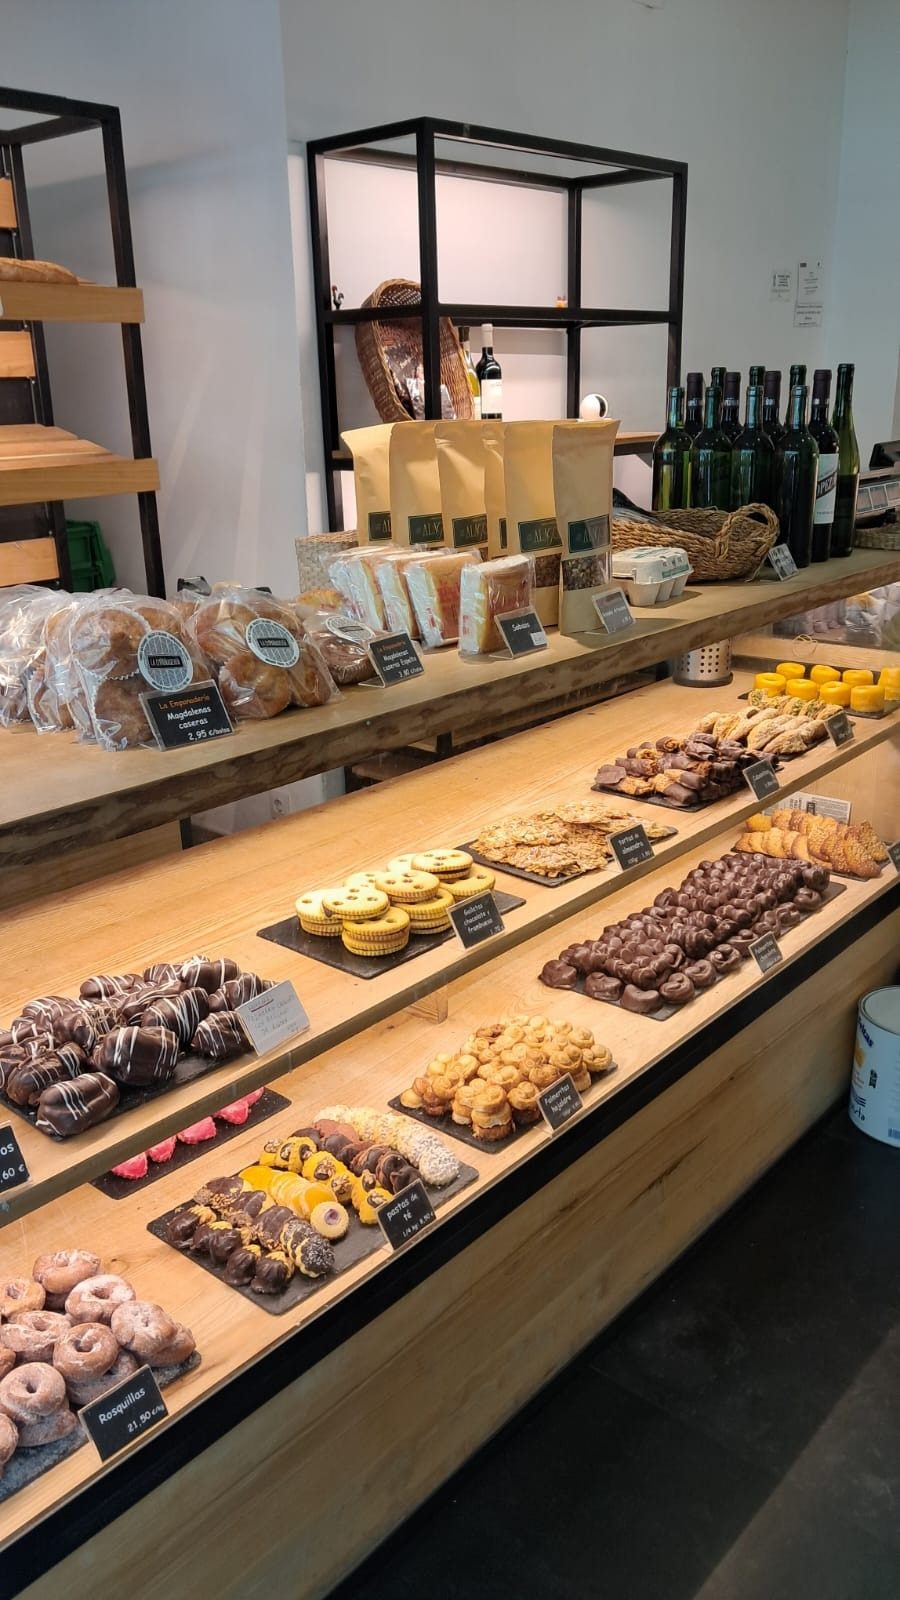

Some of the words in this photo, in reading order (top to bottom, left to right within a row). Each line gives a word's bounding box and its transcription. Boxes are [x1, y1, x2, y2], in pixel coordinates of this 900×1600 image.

[167, 706, 212, 721] Magdalenas
[178, 717, 208, 730] caseras
[187, 729, 207, 742] 2,95
[386, 1198, 410, 1221] pastas
[410, 1192, 419, 1202] de
[403, 1208, 412, 1221] té
[98, 1387, 146, 1425] Rosquillas
[127, 1410, 151, 1433] 21,50
